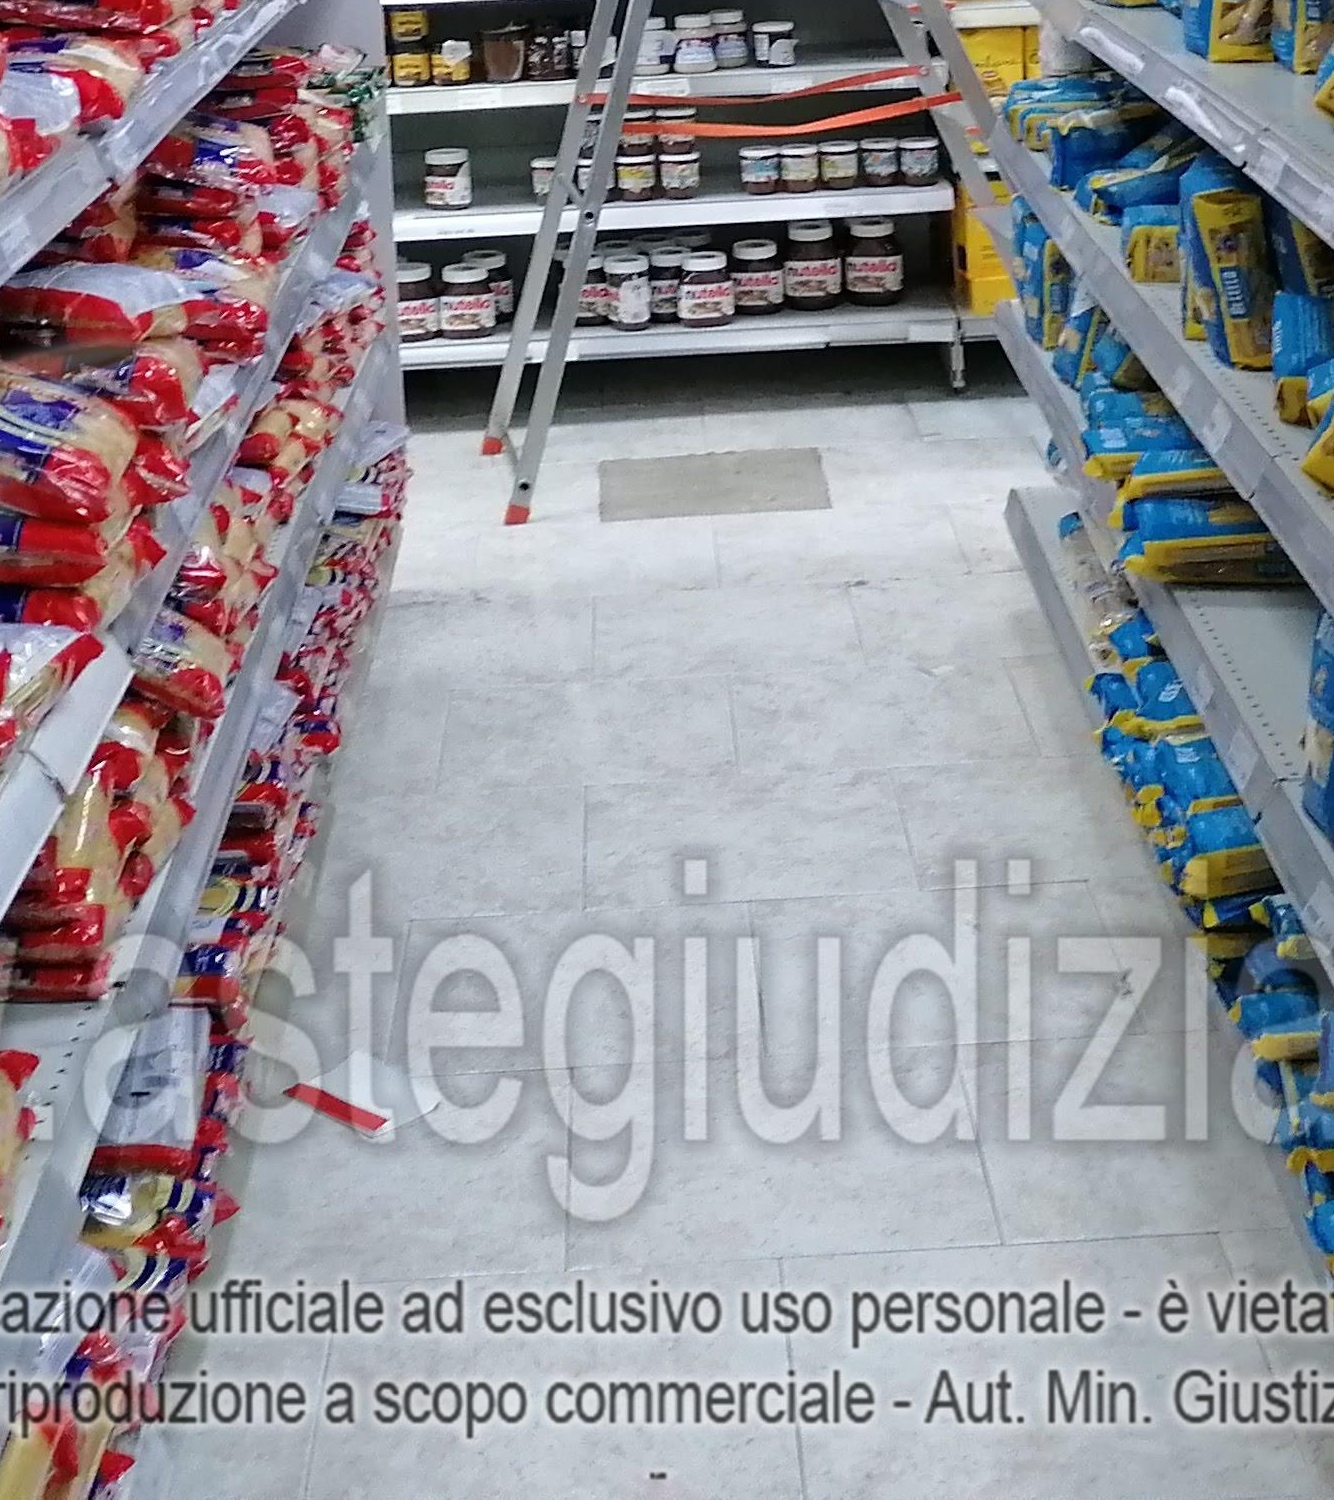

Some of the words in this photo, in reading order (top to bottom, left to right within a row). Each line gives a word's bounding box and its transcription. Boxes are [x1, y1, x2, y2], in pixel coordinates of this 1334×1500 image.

[787, 264, 838, 278] nutella
[848, 261, 897, 273] nutella
[684, 286, 731, 300] nutella
